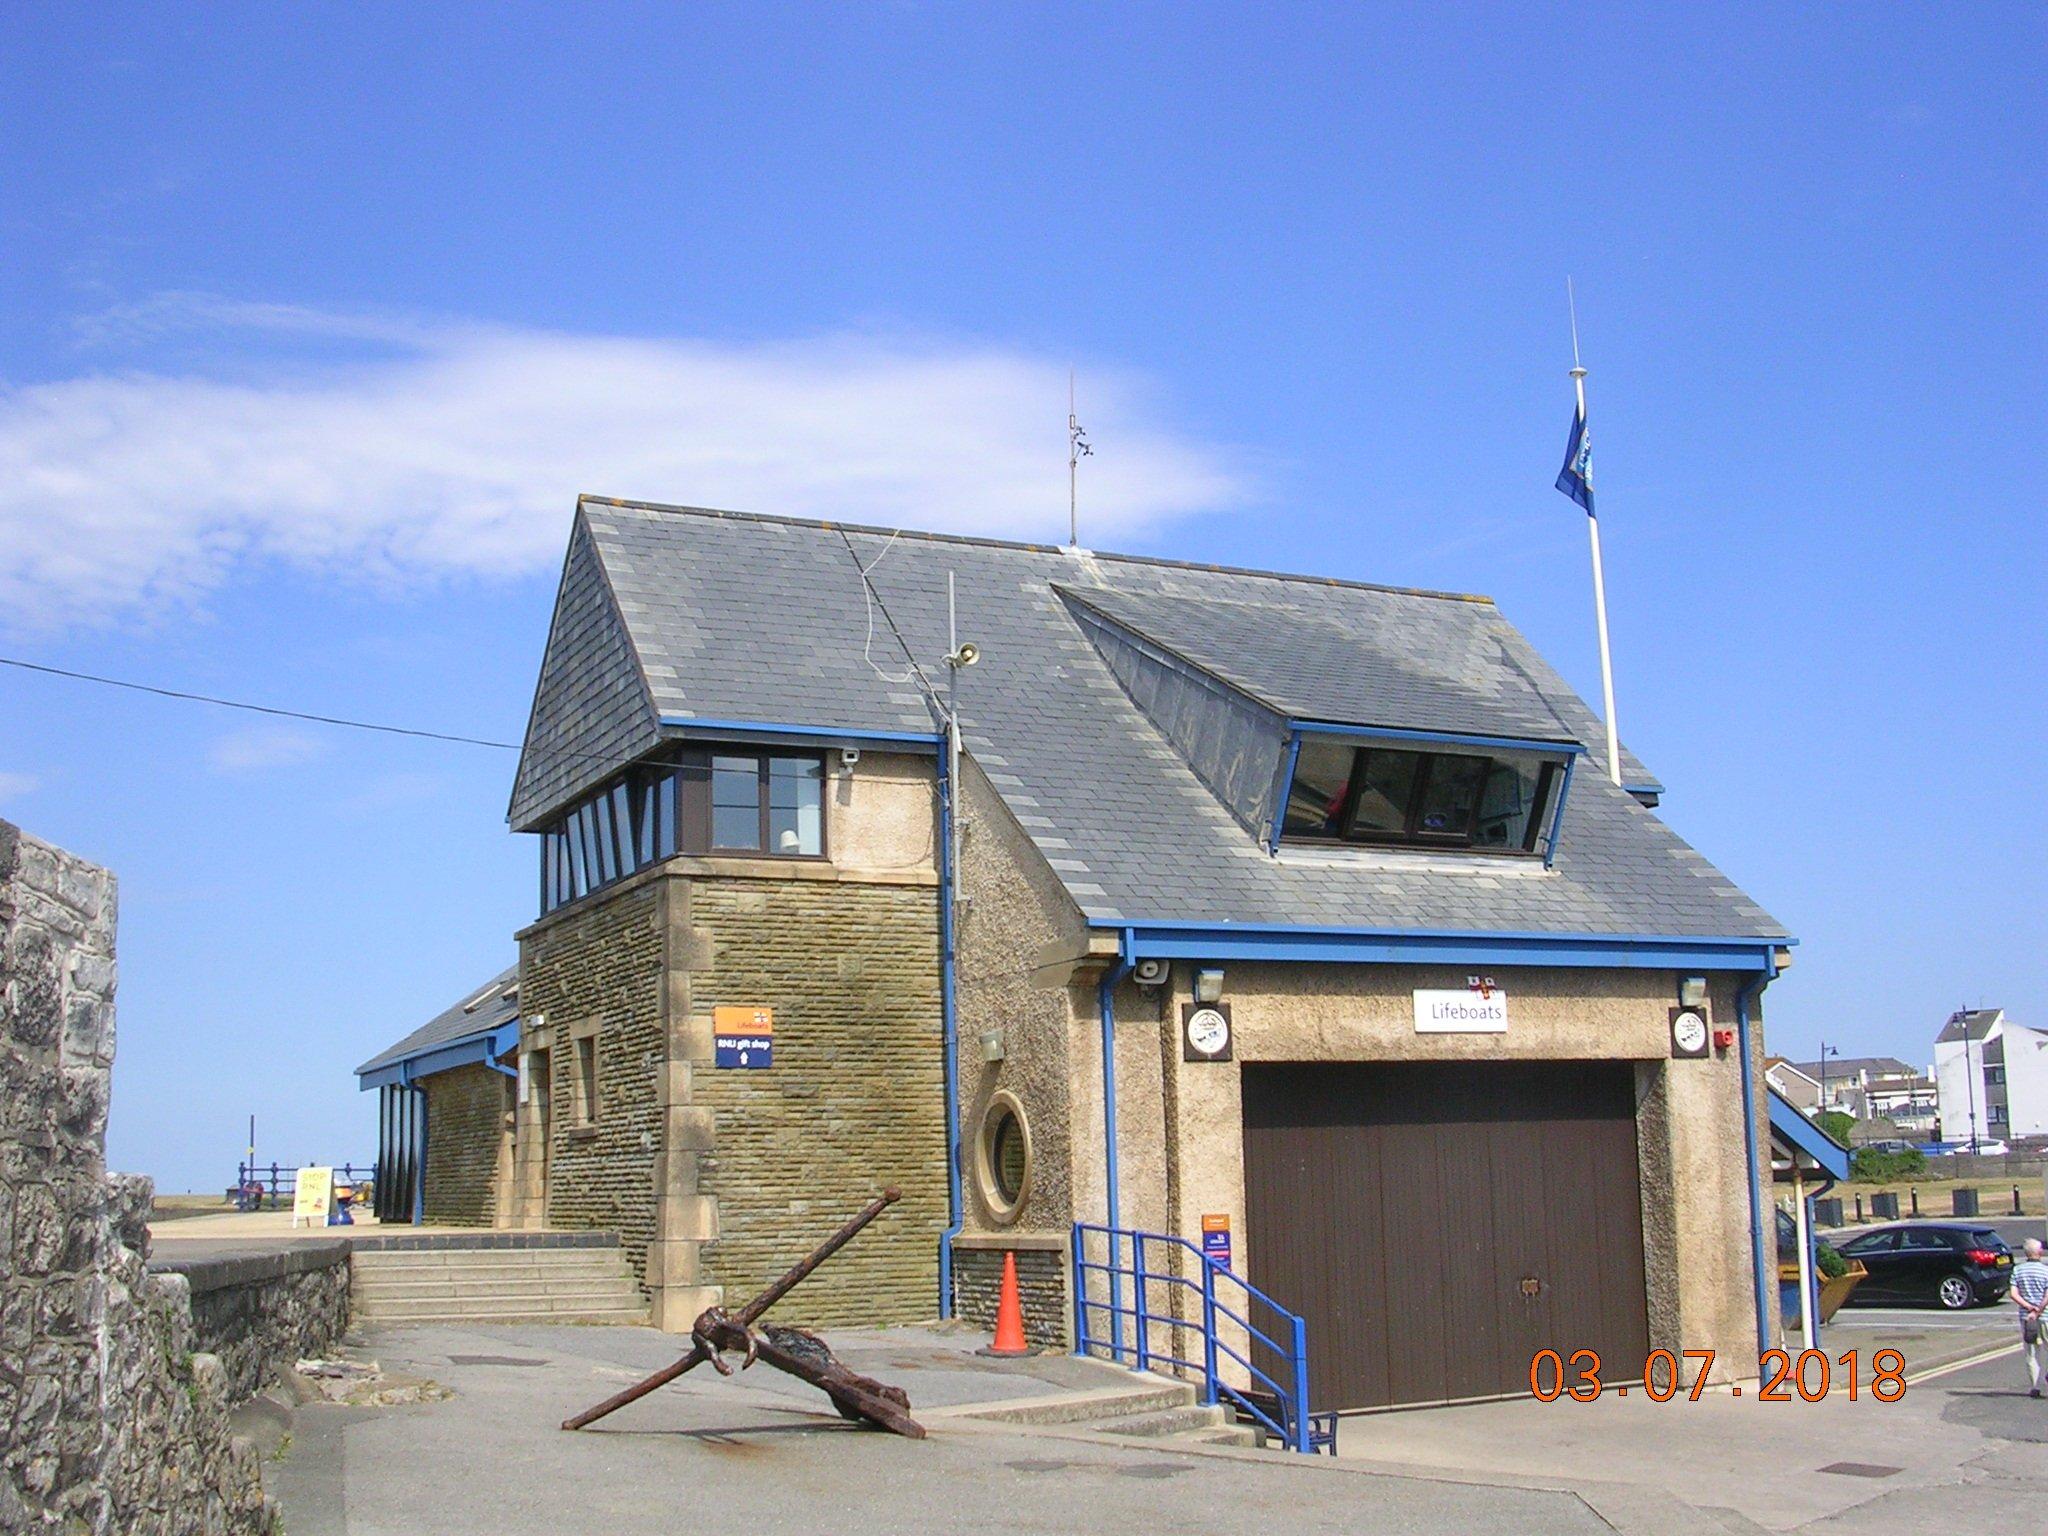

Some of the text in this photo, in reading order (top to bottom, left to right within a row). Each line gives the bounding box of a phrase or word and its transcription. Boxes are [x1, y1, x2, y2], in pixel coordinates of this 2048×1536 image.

[1432, 1002, 1502, 1020] Lifeboats
[717, 1039, 770, 1050] RNLI gift shop
